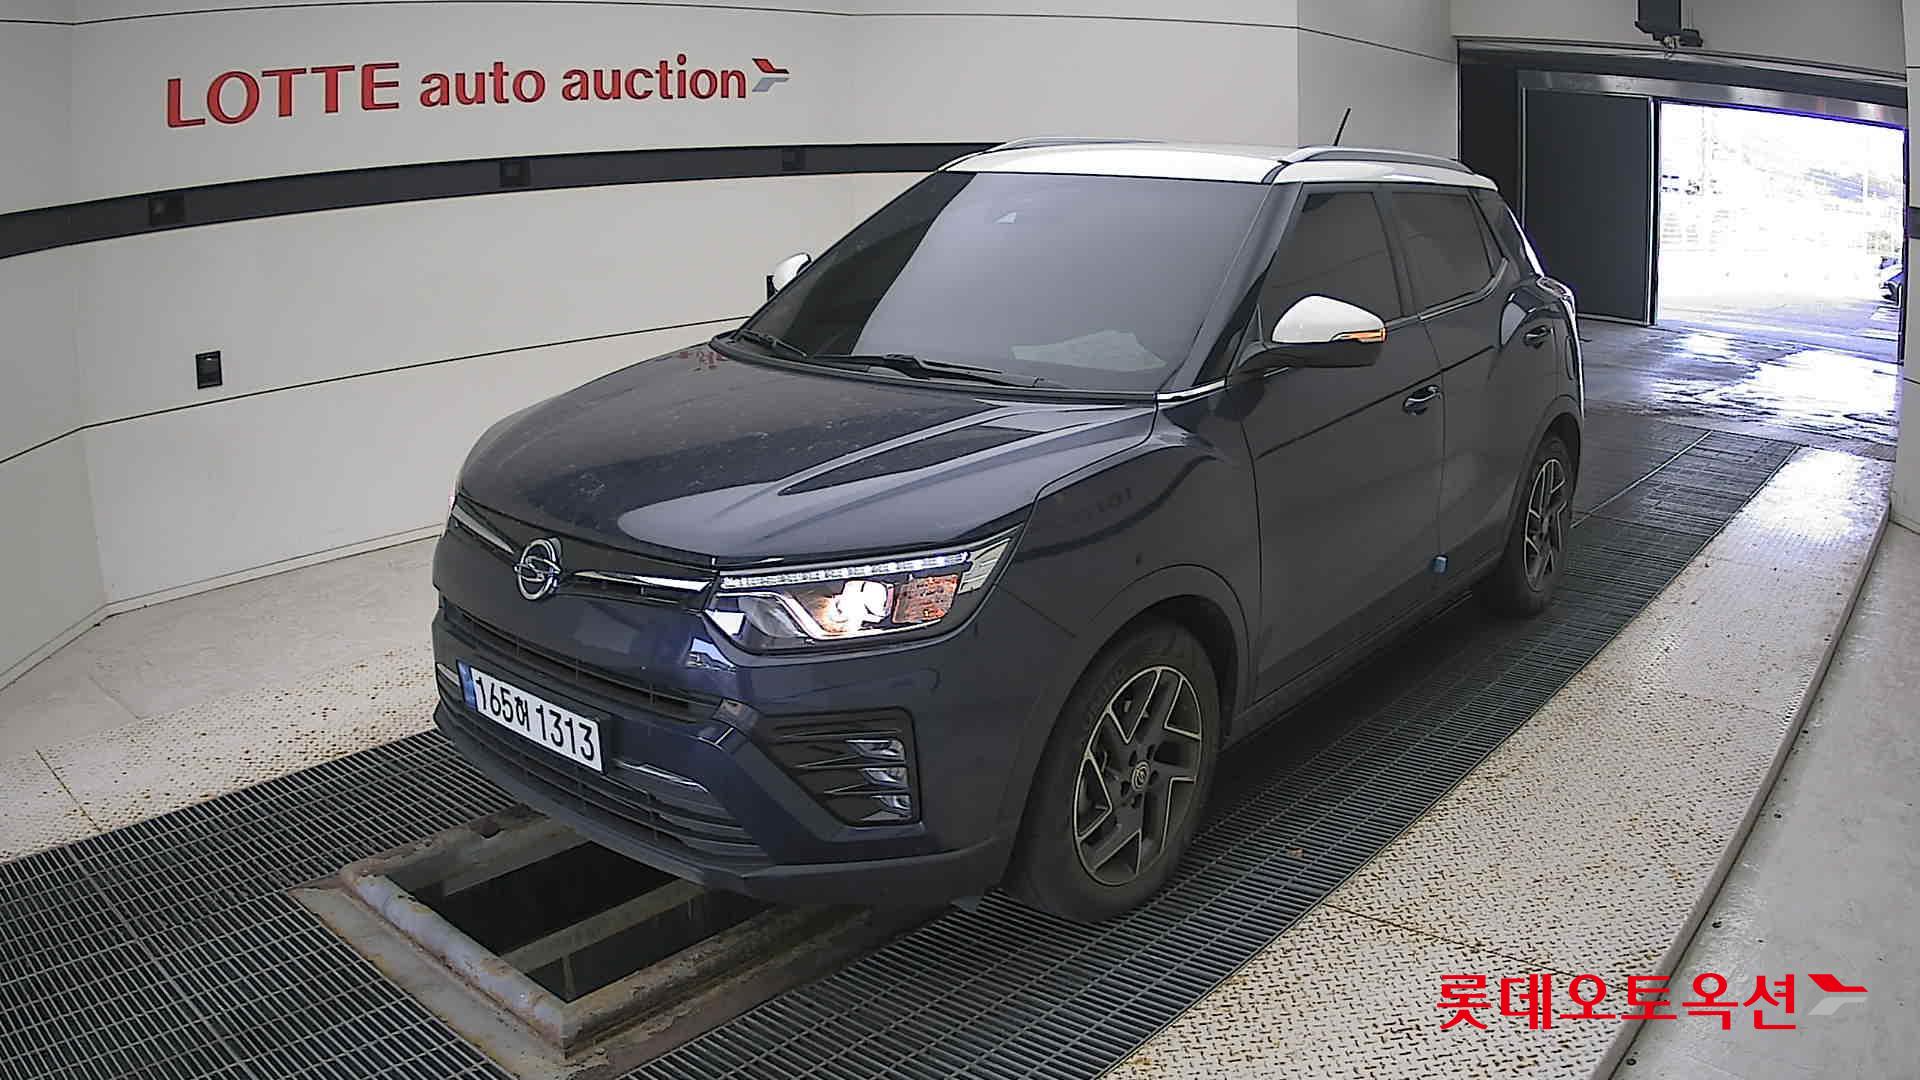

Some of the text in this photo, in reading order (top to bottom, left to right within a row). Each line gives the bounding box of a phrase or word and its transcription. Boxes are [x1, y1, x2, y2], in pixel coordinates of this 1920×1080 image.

[167, 54, 747, 128] LOTTE auto auction
[476, 677, 594, 761] 165허 1313
